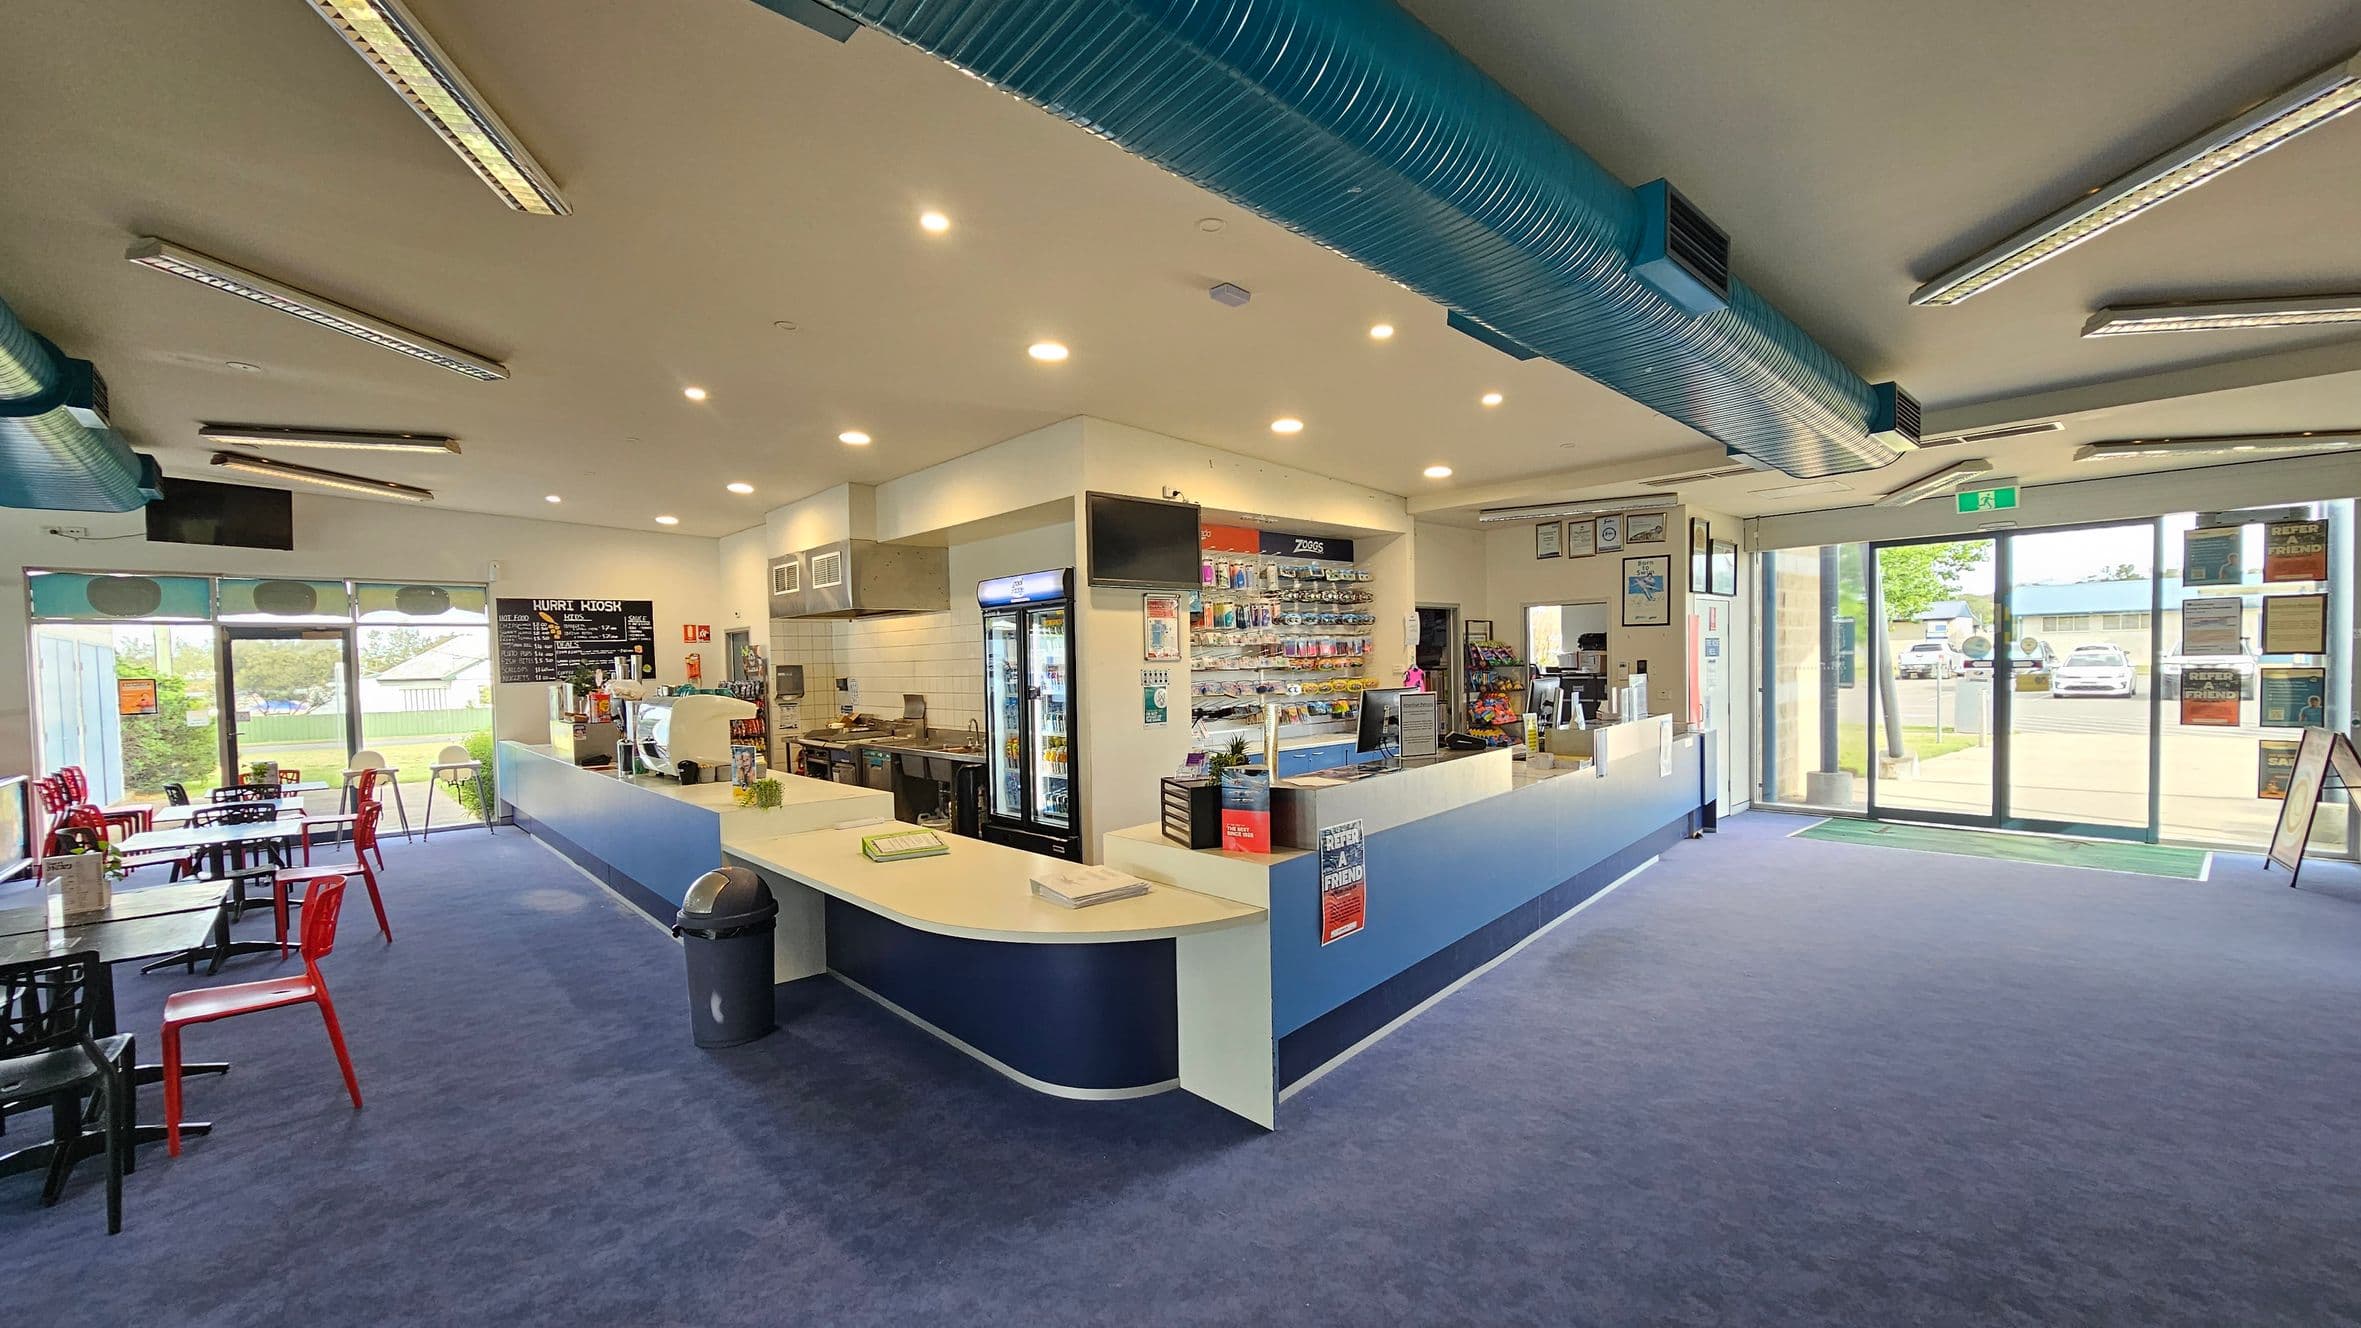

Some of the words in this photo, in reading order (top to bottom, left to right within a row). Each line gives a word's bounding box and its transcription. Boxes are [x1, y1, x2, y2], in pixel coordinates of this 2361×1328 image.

[2271, 524, 2320, 536] REFER
[1293, 539, 1324, 553] ZOGGS
[2286, 535, 2299, 545] A
[2267, 544, 2322, 555] FRIEND
[580, 600, 622, 612] KIOSK
[2188, 671, 2234, 681] REFER
[2203, 681, 2215, 690] A
[2184, 690, 2239, 700] FRIEND
[1325, 828, 1360, 852] REFER
[1338, 850, 1348, 868] A
[1323, 865, 1363, 892] FRIEND
